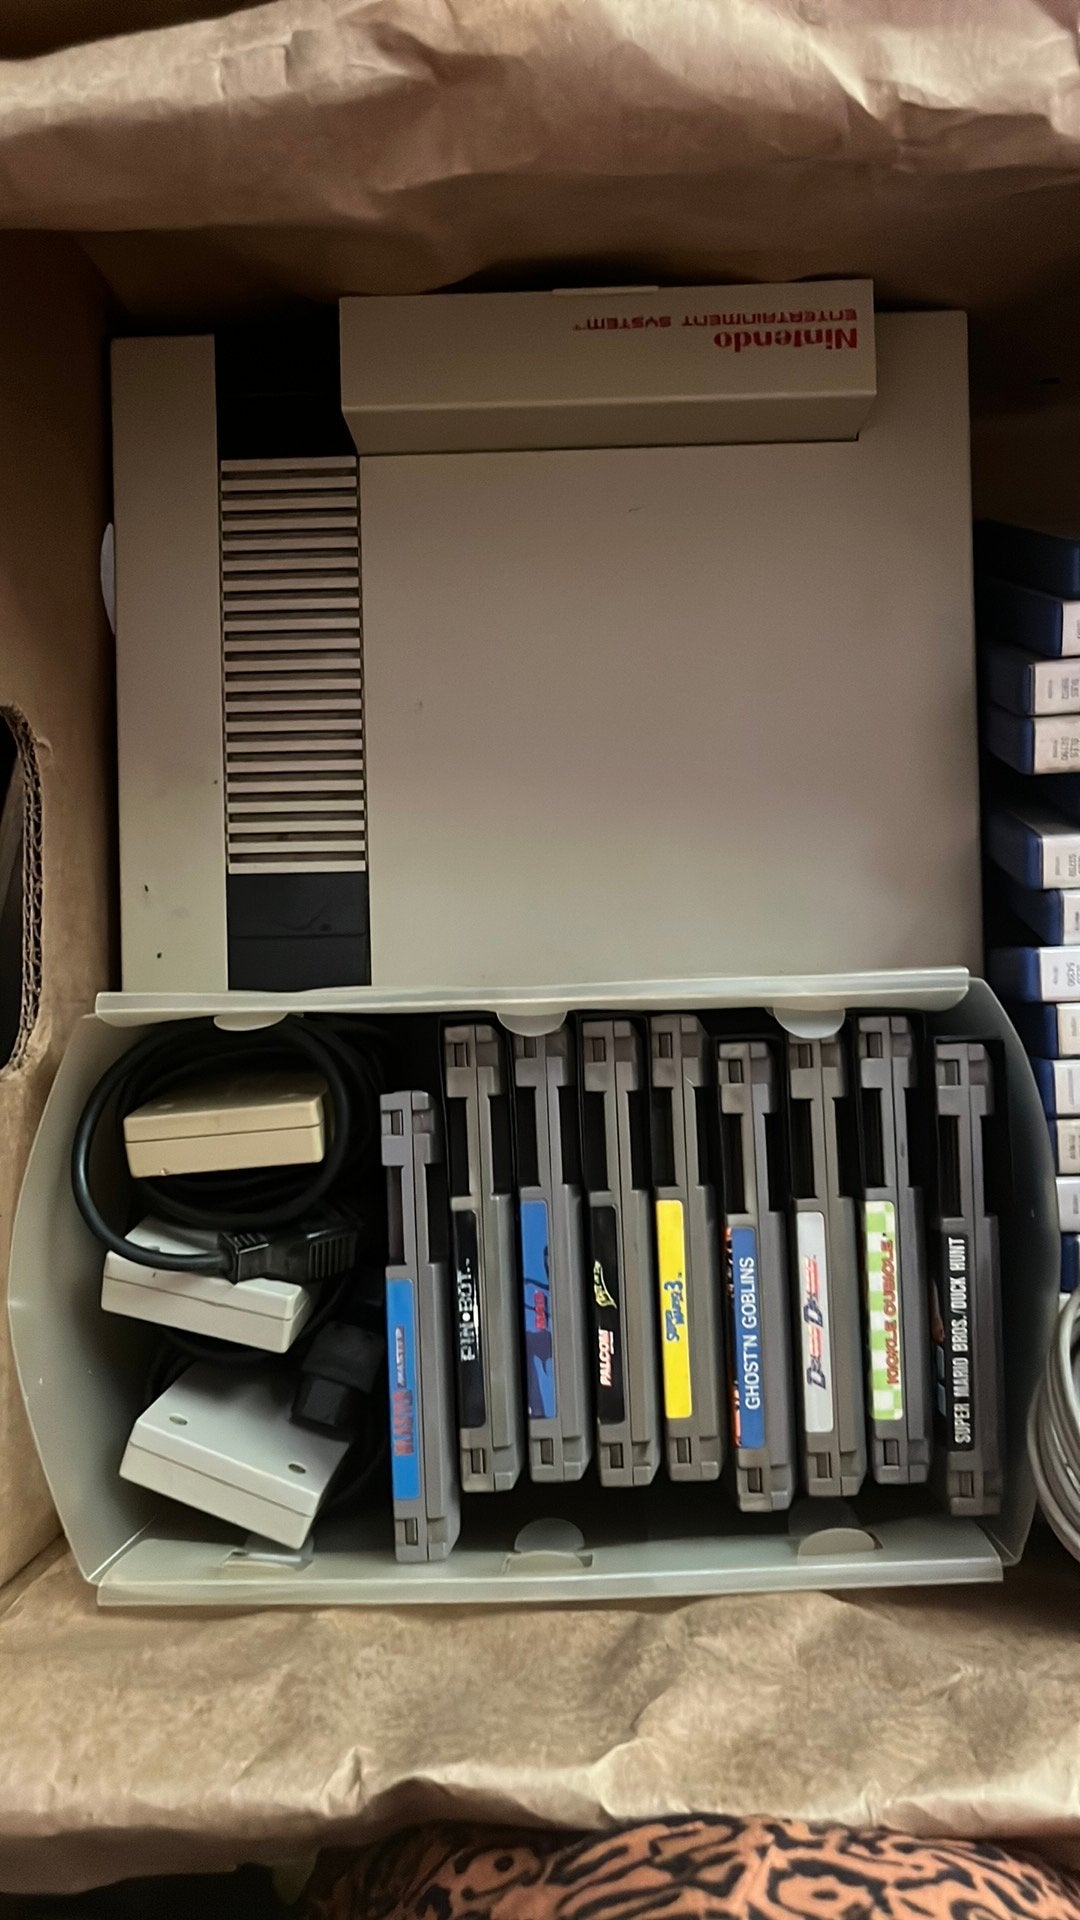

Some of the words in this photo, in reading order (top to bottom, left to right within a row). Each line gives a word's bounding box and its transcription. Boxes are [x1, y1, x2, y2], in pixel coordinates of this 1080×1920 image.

[681, 308, 857, 327] ENTERTAINMENT
[713, 327, 858, 353] Nintendo
[948, 1237, 966, 1271] HUNT
[739, 1256, 757, 1329] GOBLINS
[880, 1239, 896, 1317] CUBICLE
[598, 1328, 612, 1387] PALCOM
[883, 1320, 900, 1385] KICKLE
[952, 1357, 969, 1397] MARIO
[954, 1403, 971, 1444] SUPER
